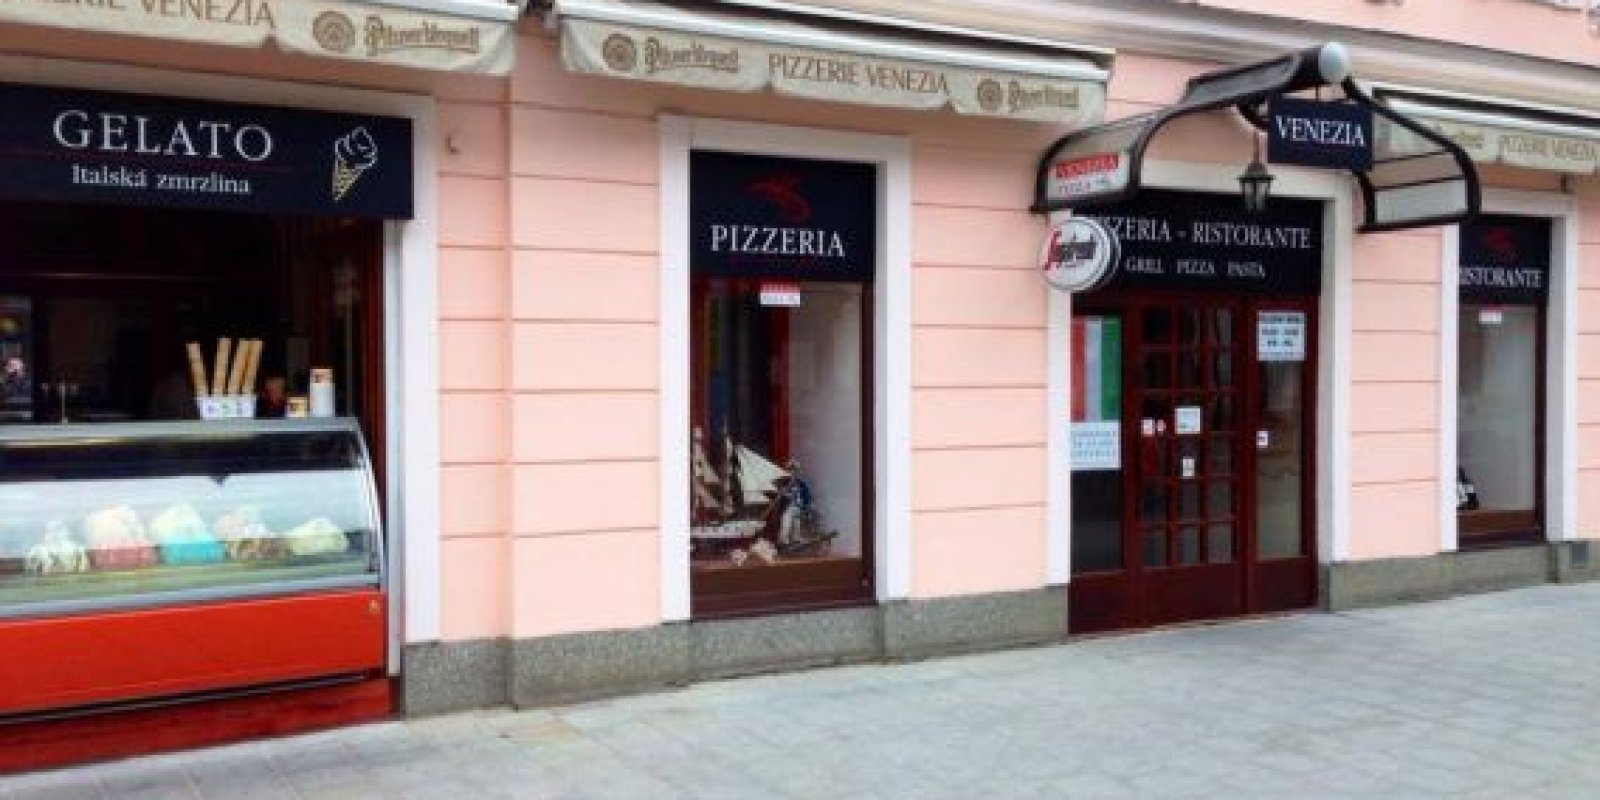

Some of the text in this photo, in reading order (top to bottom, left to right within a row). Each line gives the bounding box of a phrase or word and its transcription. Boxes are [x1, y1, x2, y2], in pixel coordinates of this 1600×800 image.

[768, 53, 950, 94] PIZZERIE VENEZIA
[53, 109, 273, 161] GELATO
[1275, 115, 1366, 147] VENEZIA
[72, 163, 250, 193] Italská zmrzlina
[711, 225, 845, 257] PIZZERIA
[1193, 221, 1312, 248] RISTORANTE
[1126, 256, 1164, 274] GRILL
[1176, 259, 1215, 274] PIZZA
[1459, 266, 1542, 288] ISTORANTE
